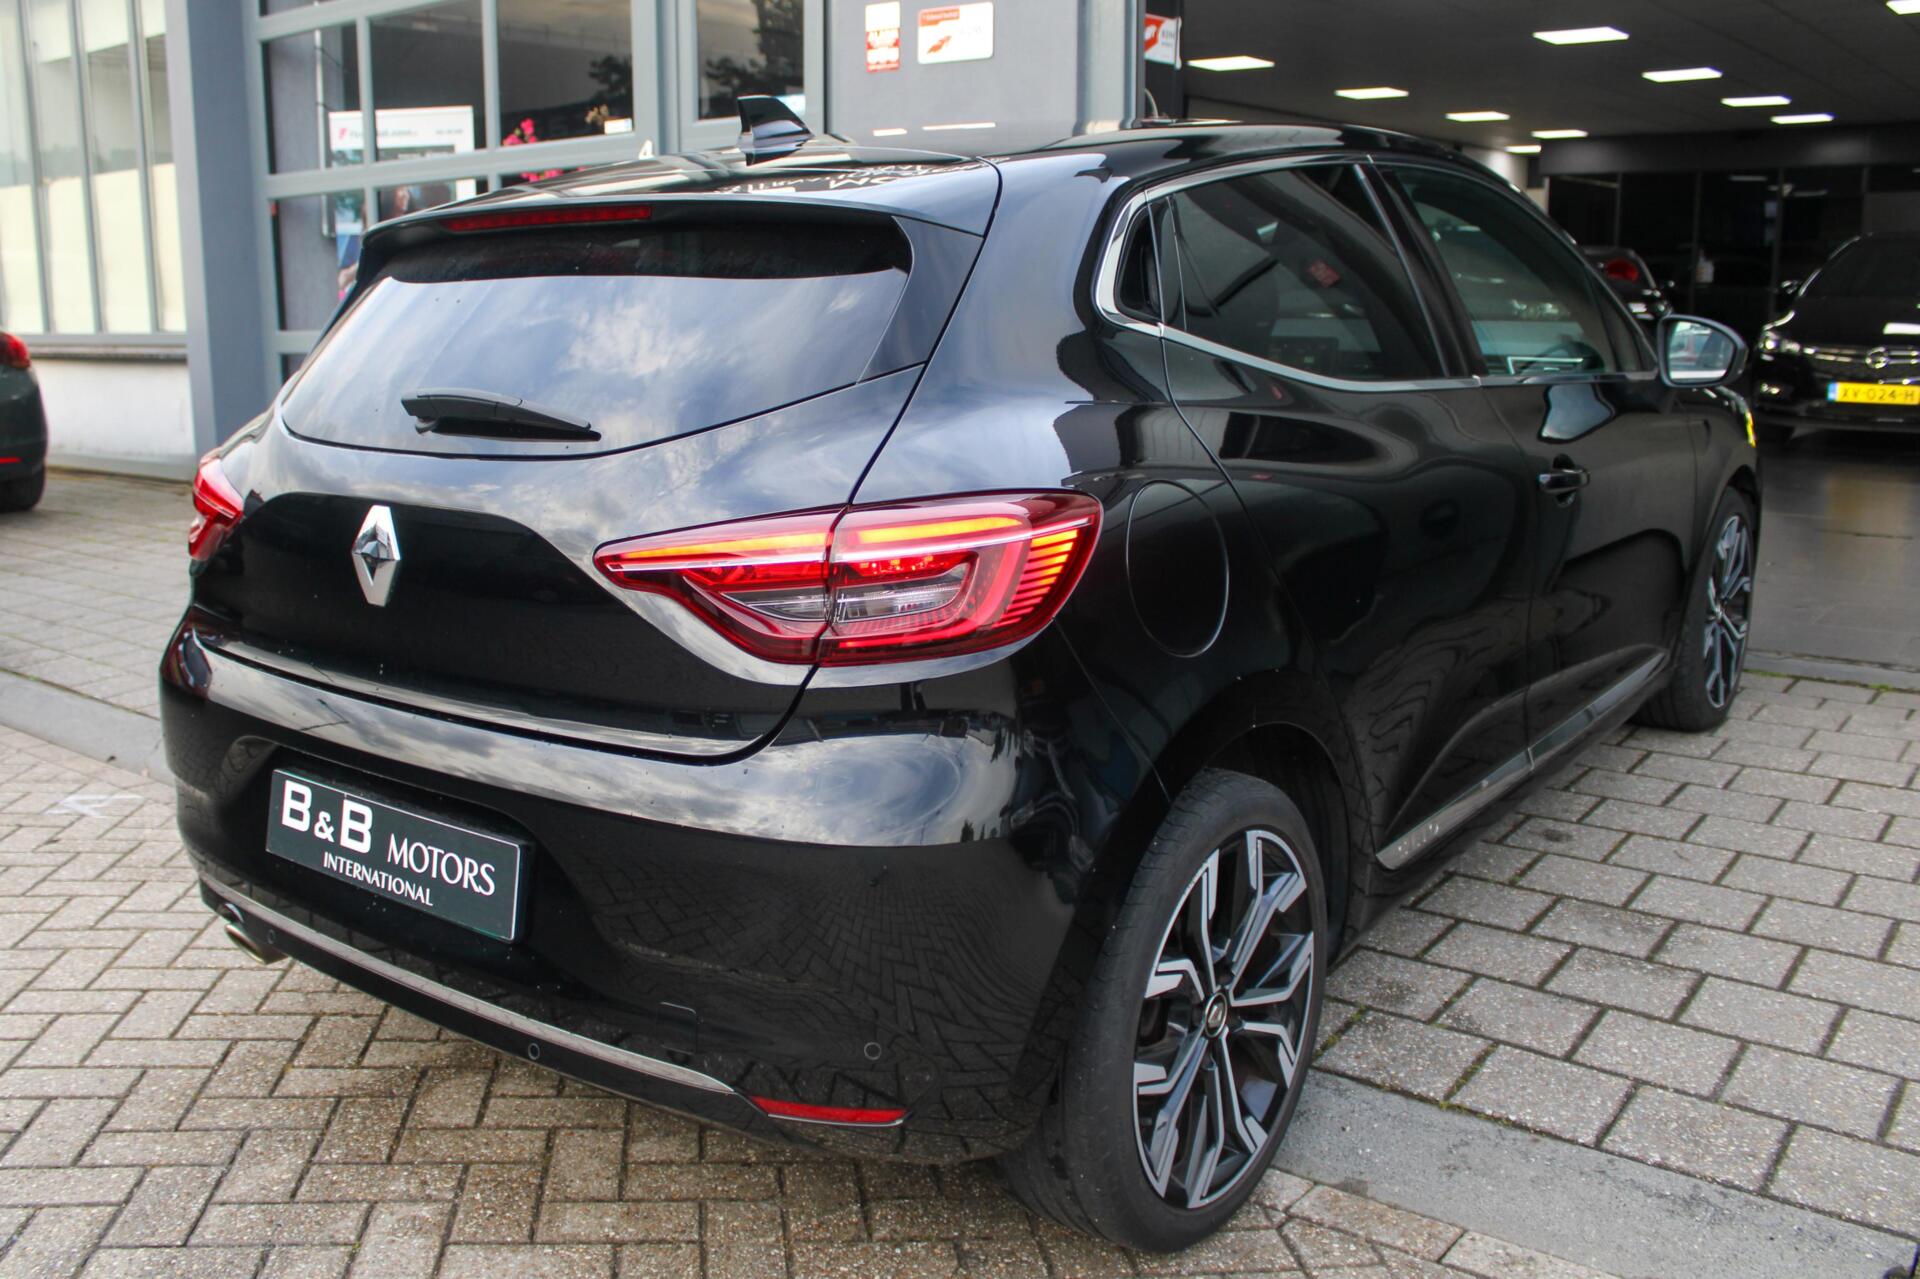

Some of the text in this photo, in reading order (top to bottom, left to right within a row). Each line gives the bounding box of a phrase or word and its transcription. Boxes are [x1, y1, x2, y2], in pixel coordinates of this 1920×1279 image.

[281, 780, 496, 897] B&B MOTORS
[323, 851, 434, 907] INTERNATIONAL
